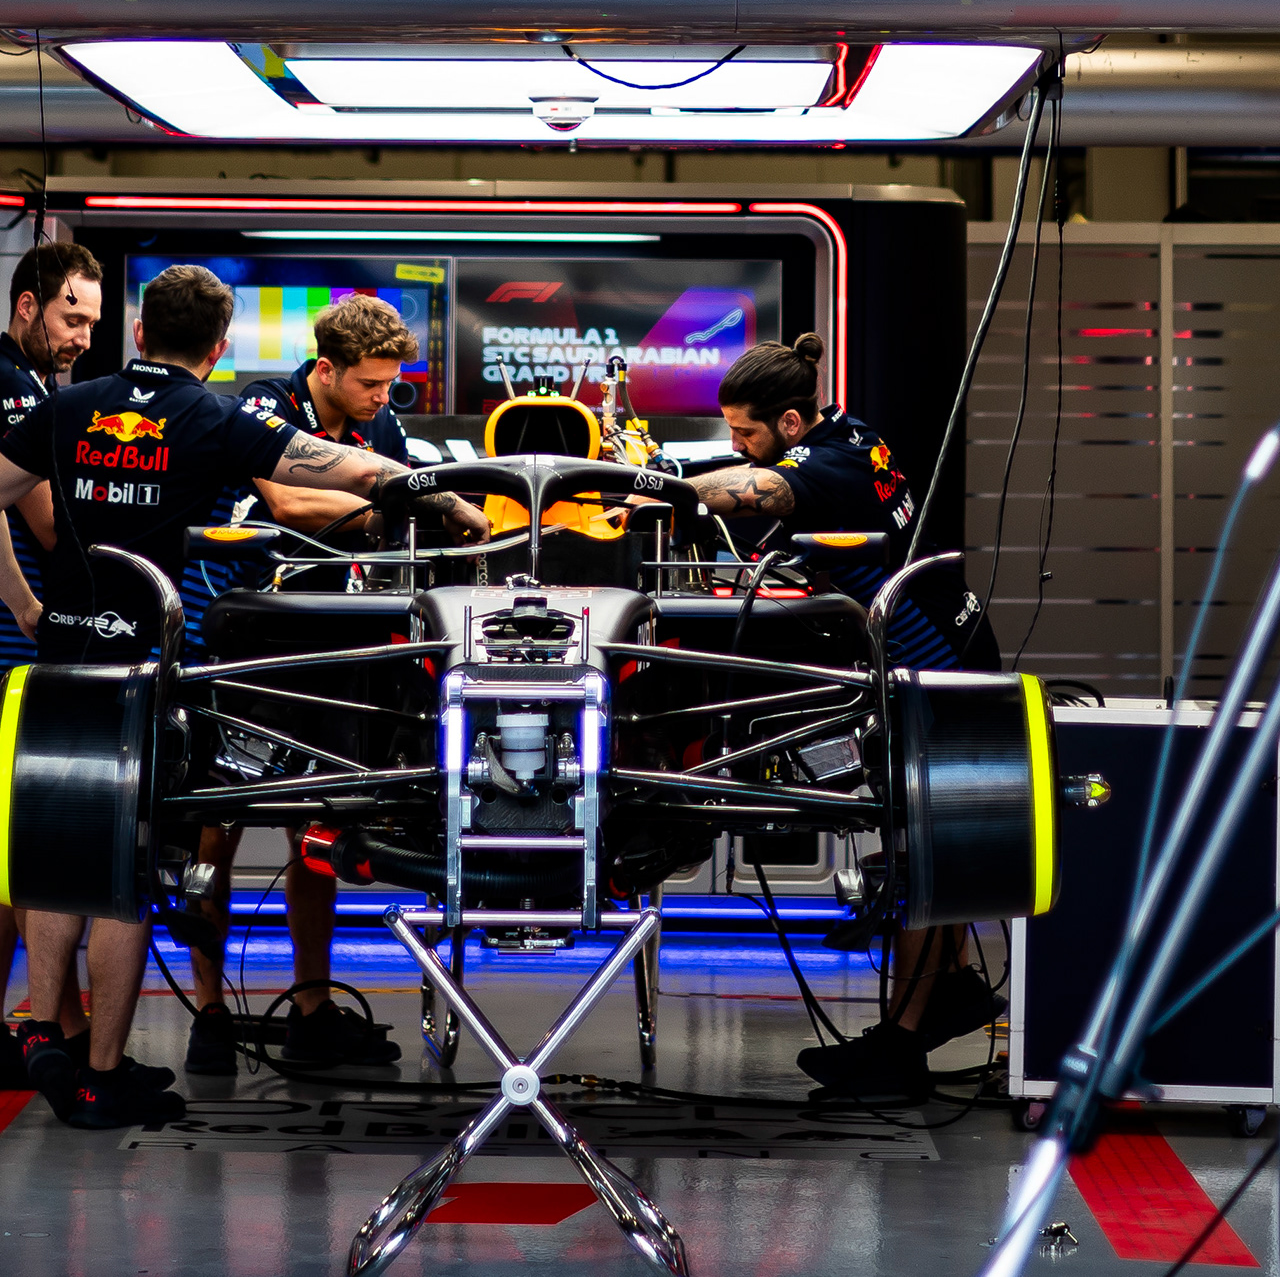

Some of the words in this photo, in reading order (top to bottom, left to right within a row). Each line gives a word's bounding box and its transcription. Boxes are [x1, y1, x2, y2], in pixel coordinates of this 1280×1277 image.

[482, 326, 602, 345] FORMULA
[604, 327, 619, 345] 1
[482, 346, 531, 365] STC
[532, 346, 605, 365] SAUDI
[609, 347, 720, 366] ARABIAN
[132, 363, 169, 376] HONDA
[482, 365, 569, 384] GRAND
[75, 440, 122, 468] Red
[122, 445, 170, 472] Bull
[75, 477, 135, 505] Mobil
